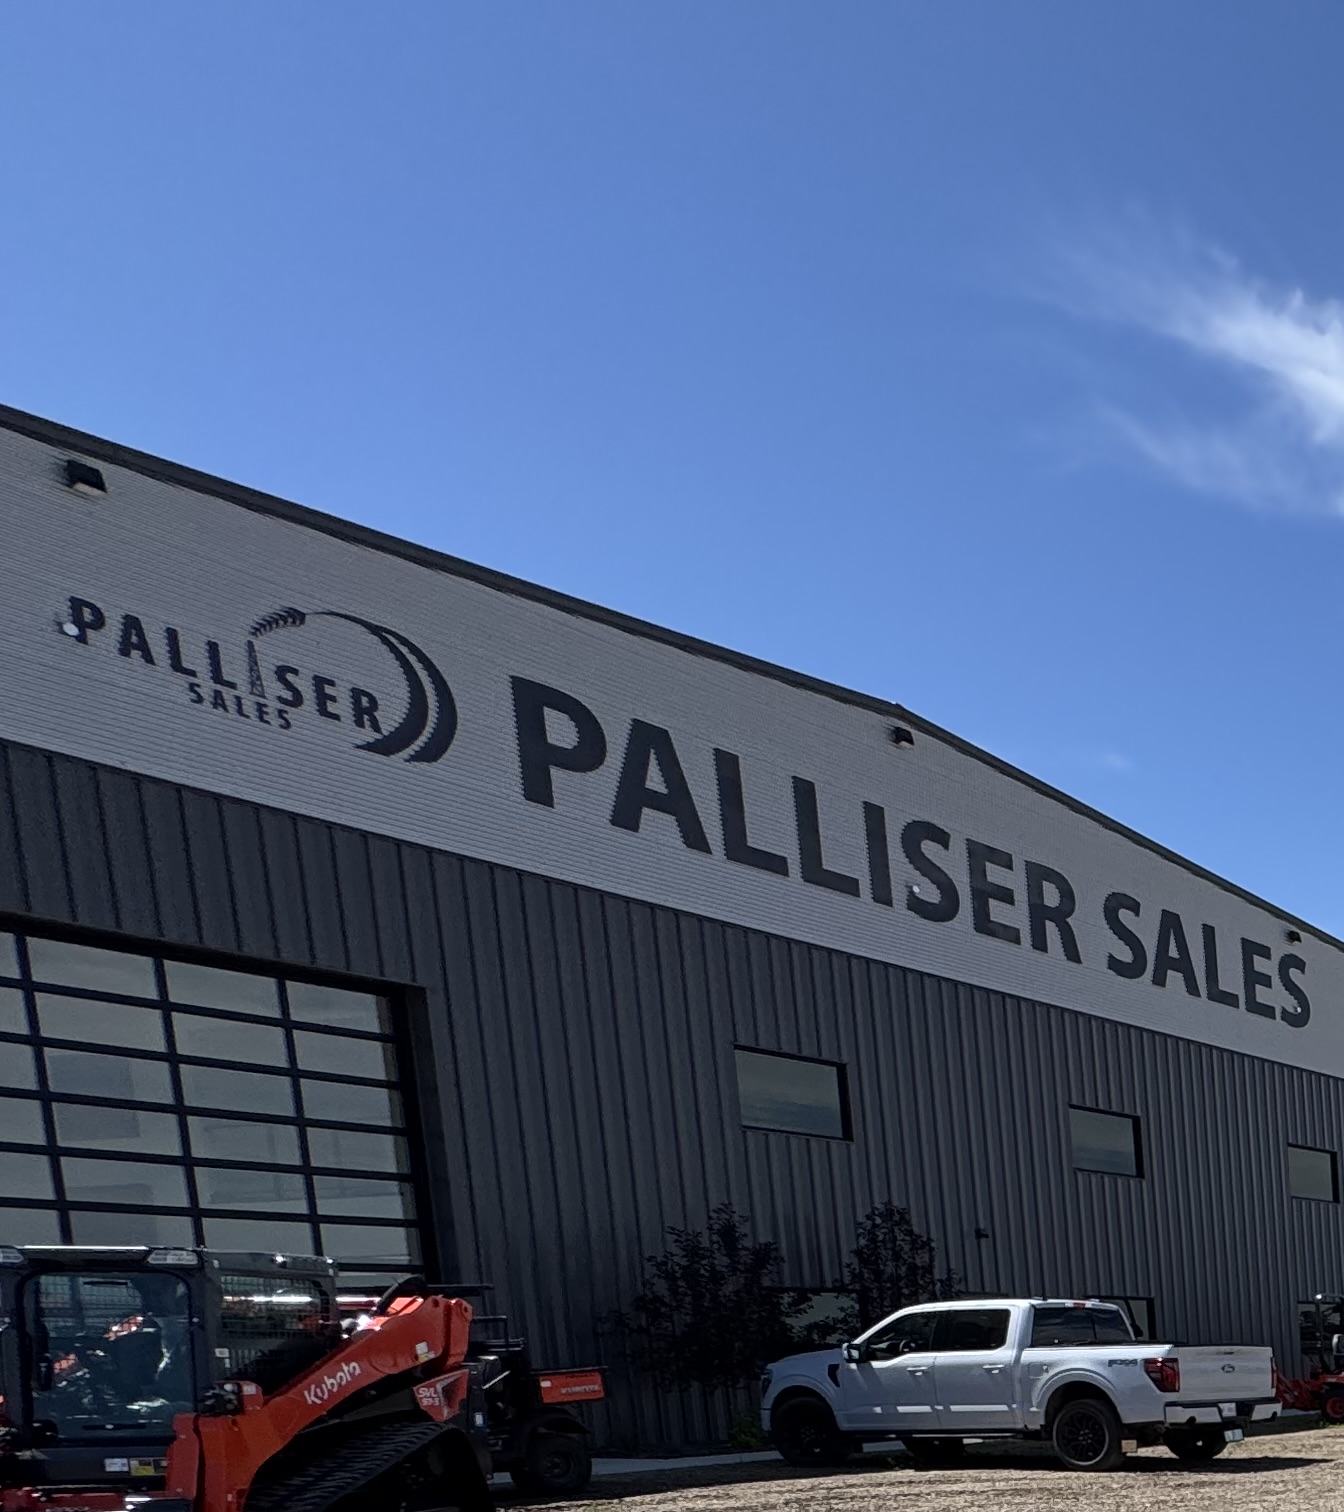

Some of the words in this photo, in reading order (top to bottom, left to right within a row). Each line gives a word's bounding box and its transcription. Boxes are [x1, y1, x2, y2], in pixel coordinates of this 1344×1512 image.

[66, 595, 385, 735] PALLISER
[189, 682, 292, 730] SALES
[510, 675, 1083, 965] PALLISER
[1103, 891, 1311, 1029] SALES
[303, 1361, 362, 1405] Kubota
